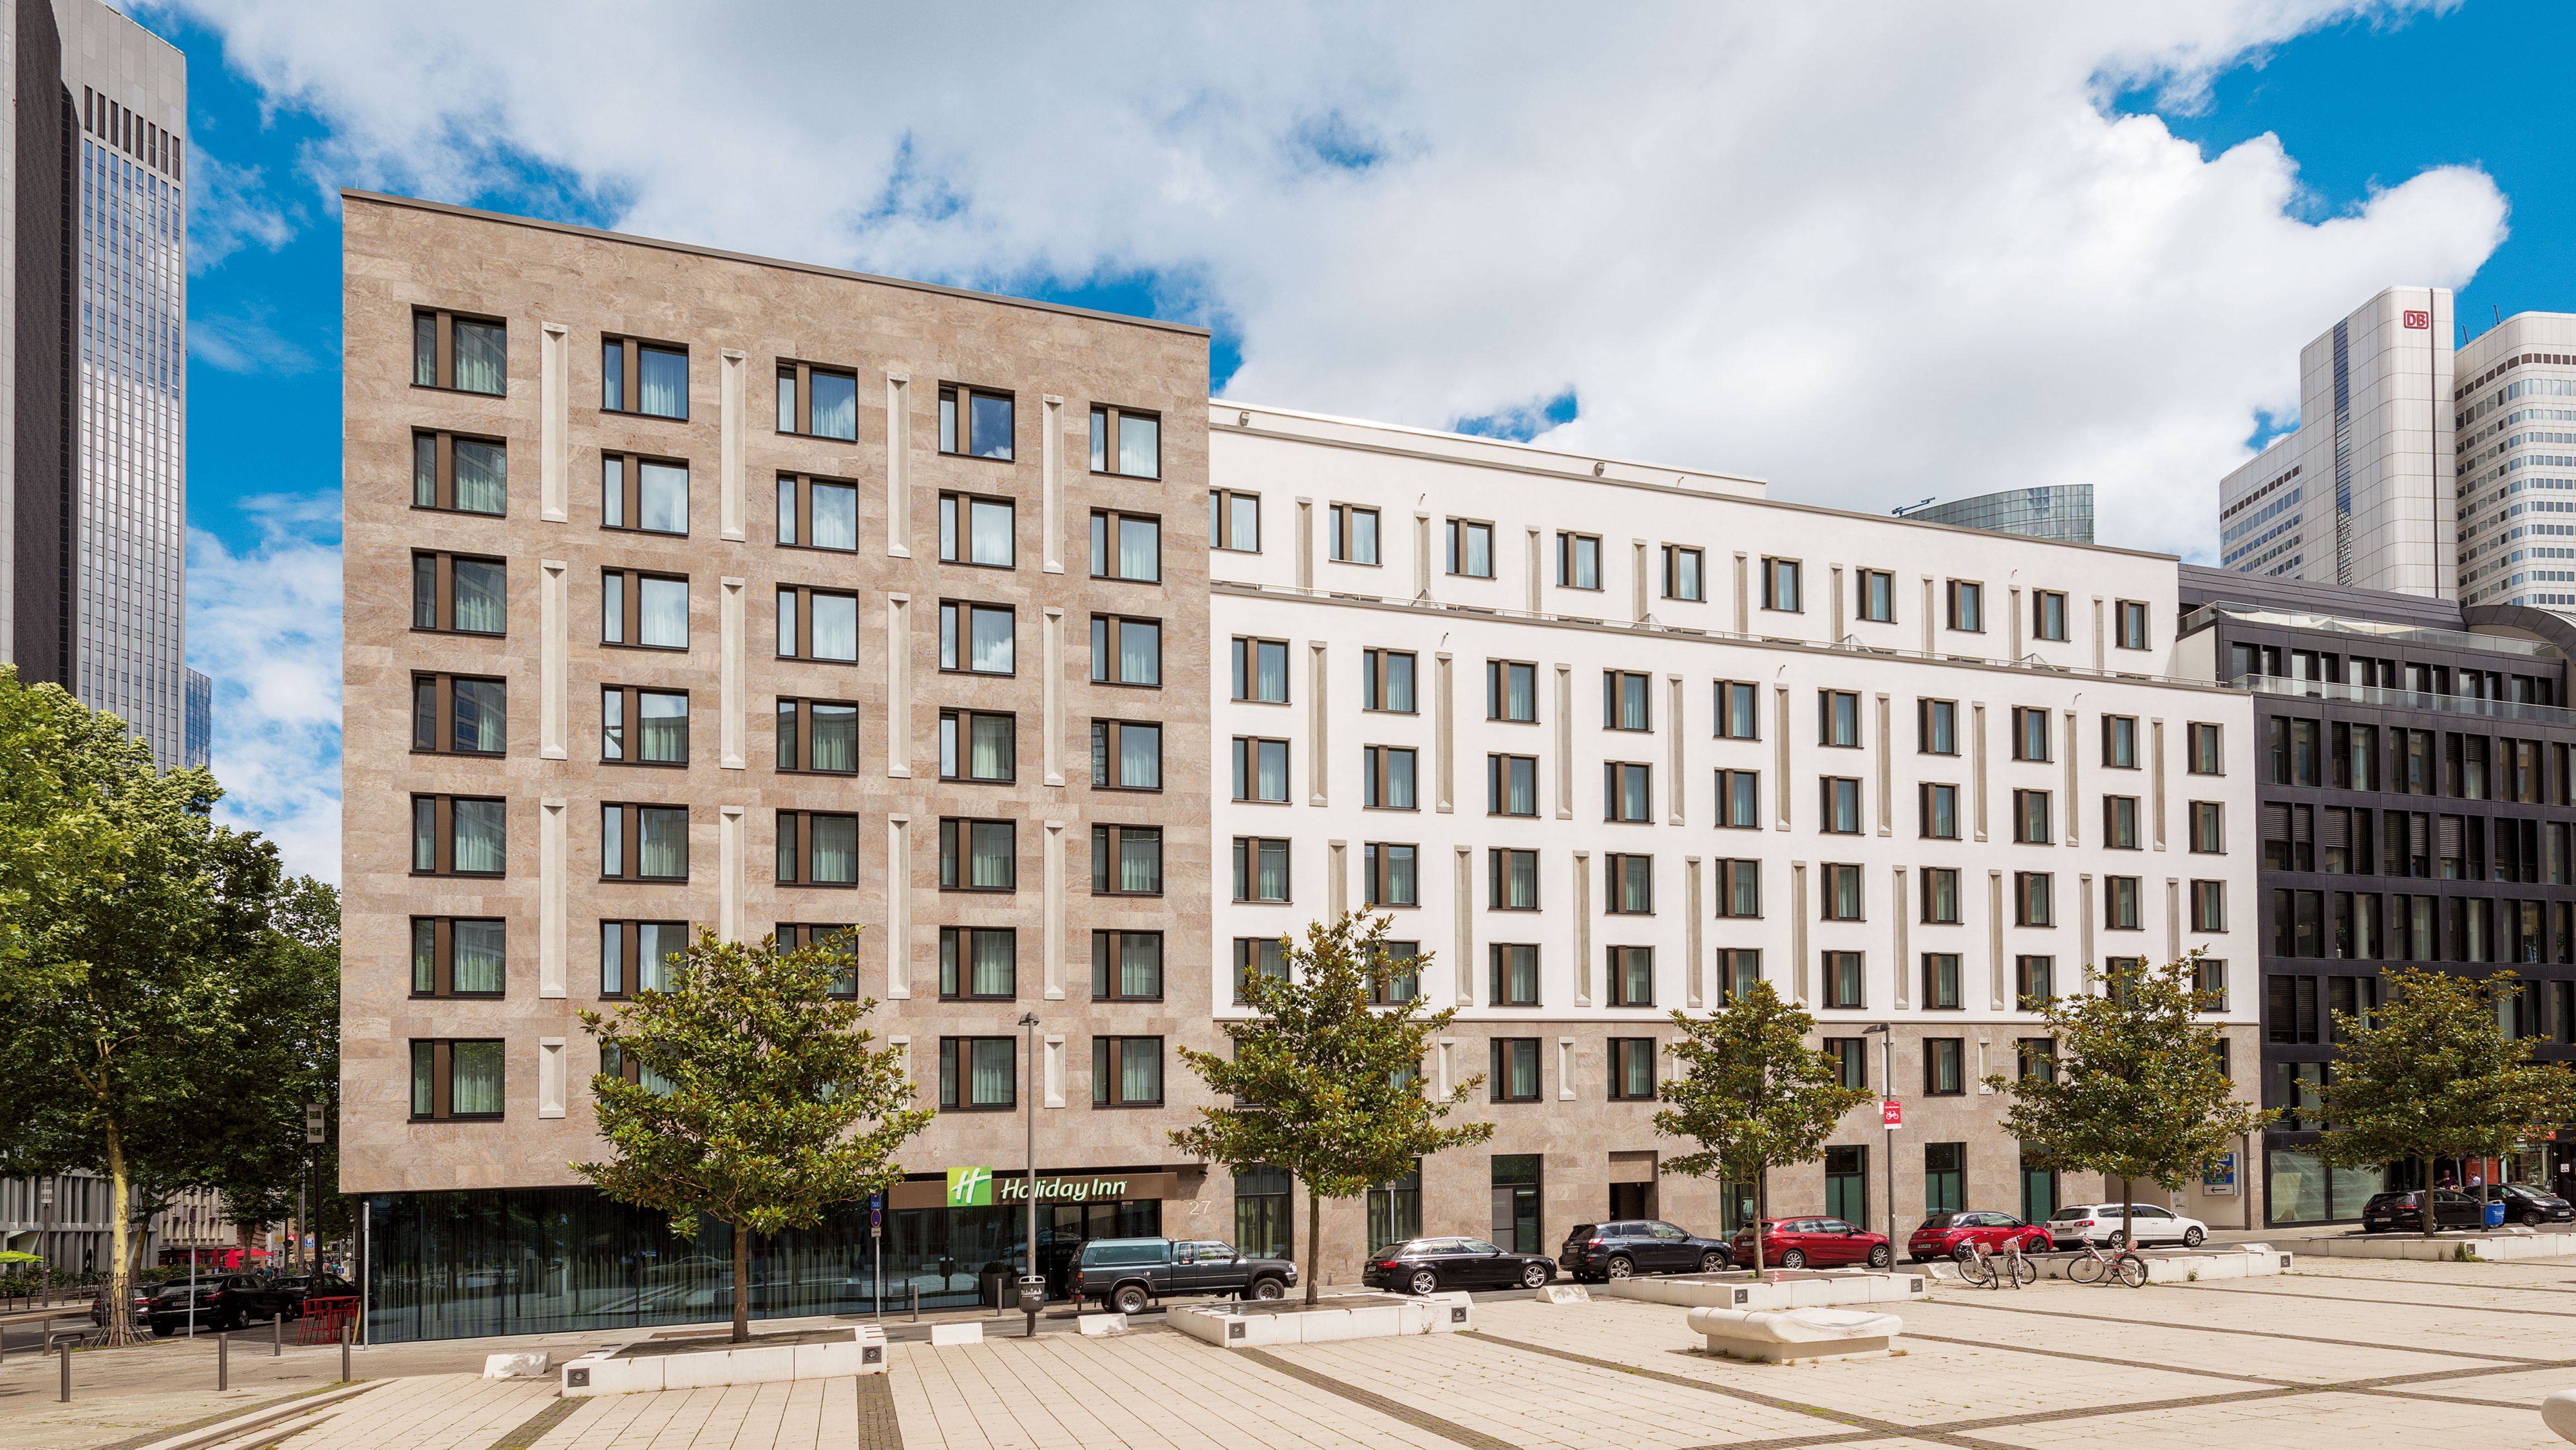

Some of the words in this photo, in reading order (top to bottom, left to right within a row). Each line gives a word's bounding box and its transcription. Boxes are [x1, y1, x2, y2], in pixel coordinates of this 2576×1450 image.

[2406, 312, 2427, 327] DB
[1001, 1178, 1089, 1201] Holiday
[1092, 1178, 1126, 1196] Inn
[1189, 1200, 1211, 1215] 27
